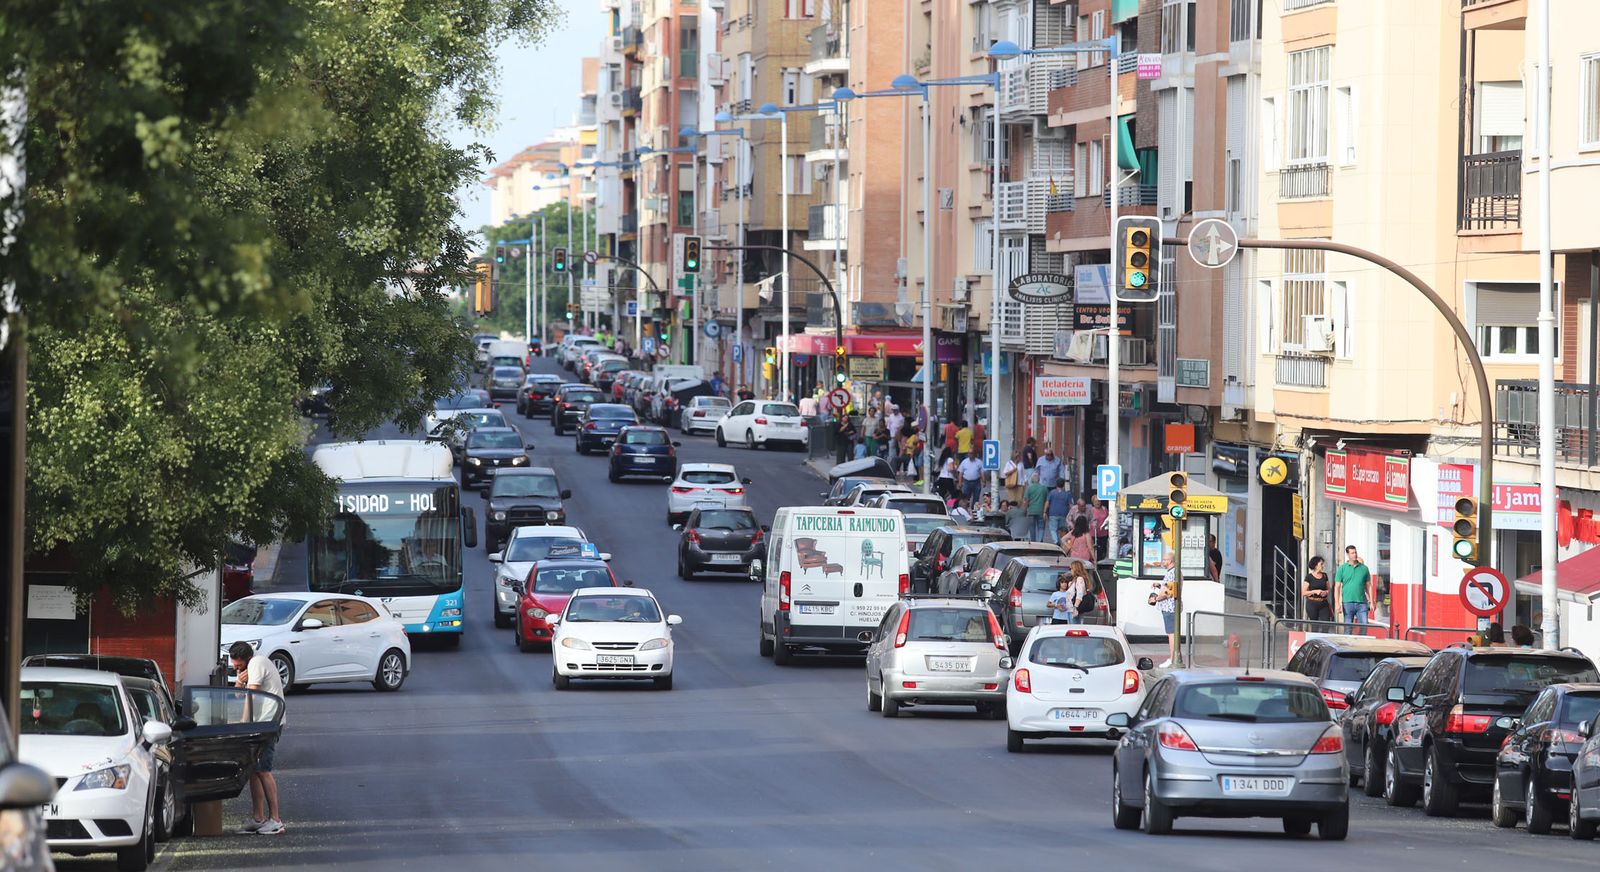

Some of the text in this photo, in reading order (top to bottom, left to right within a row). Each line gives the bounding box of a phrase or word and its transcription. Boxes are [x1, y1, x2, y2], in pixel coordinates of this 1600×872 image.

[1080, 314, 1094, 324] Dr.
[938, 338, 961, 346] GAME
[1040, 389, 1087, 397] Valenciana
[985, 444, 996, 466] P
[1102, 469, 1116, 496] P
[796, 516, 896, 532] TAPICERIA RAIMUNDO
[1060, 710, 1098, 718] 4644 JFD
[1233, 779, 1284, 790] 1341 DDD
[41, 804, 58, 816] FM
